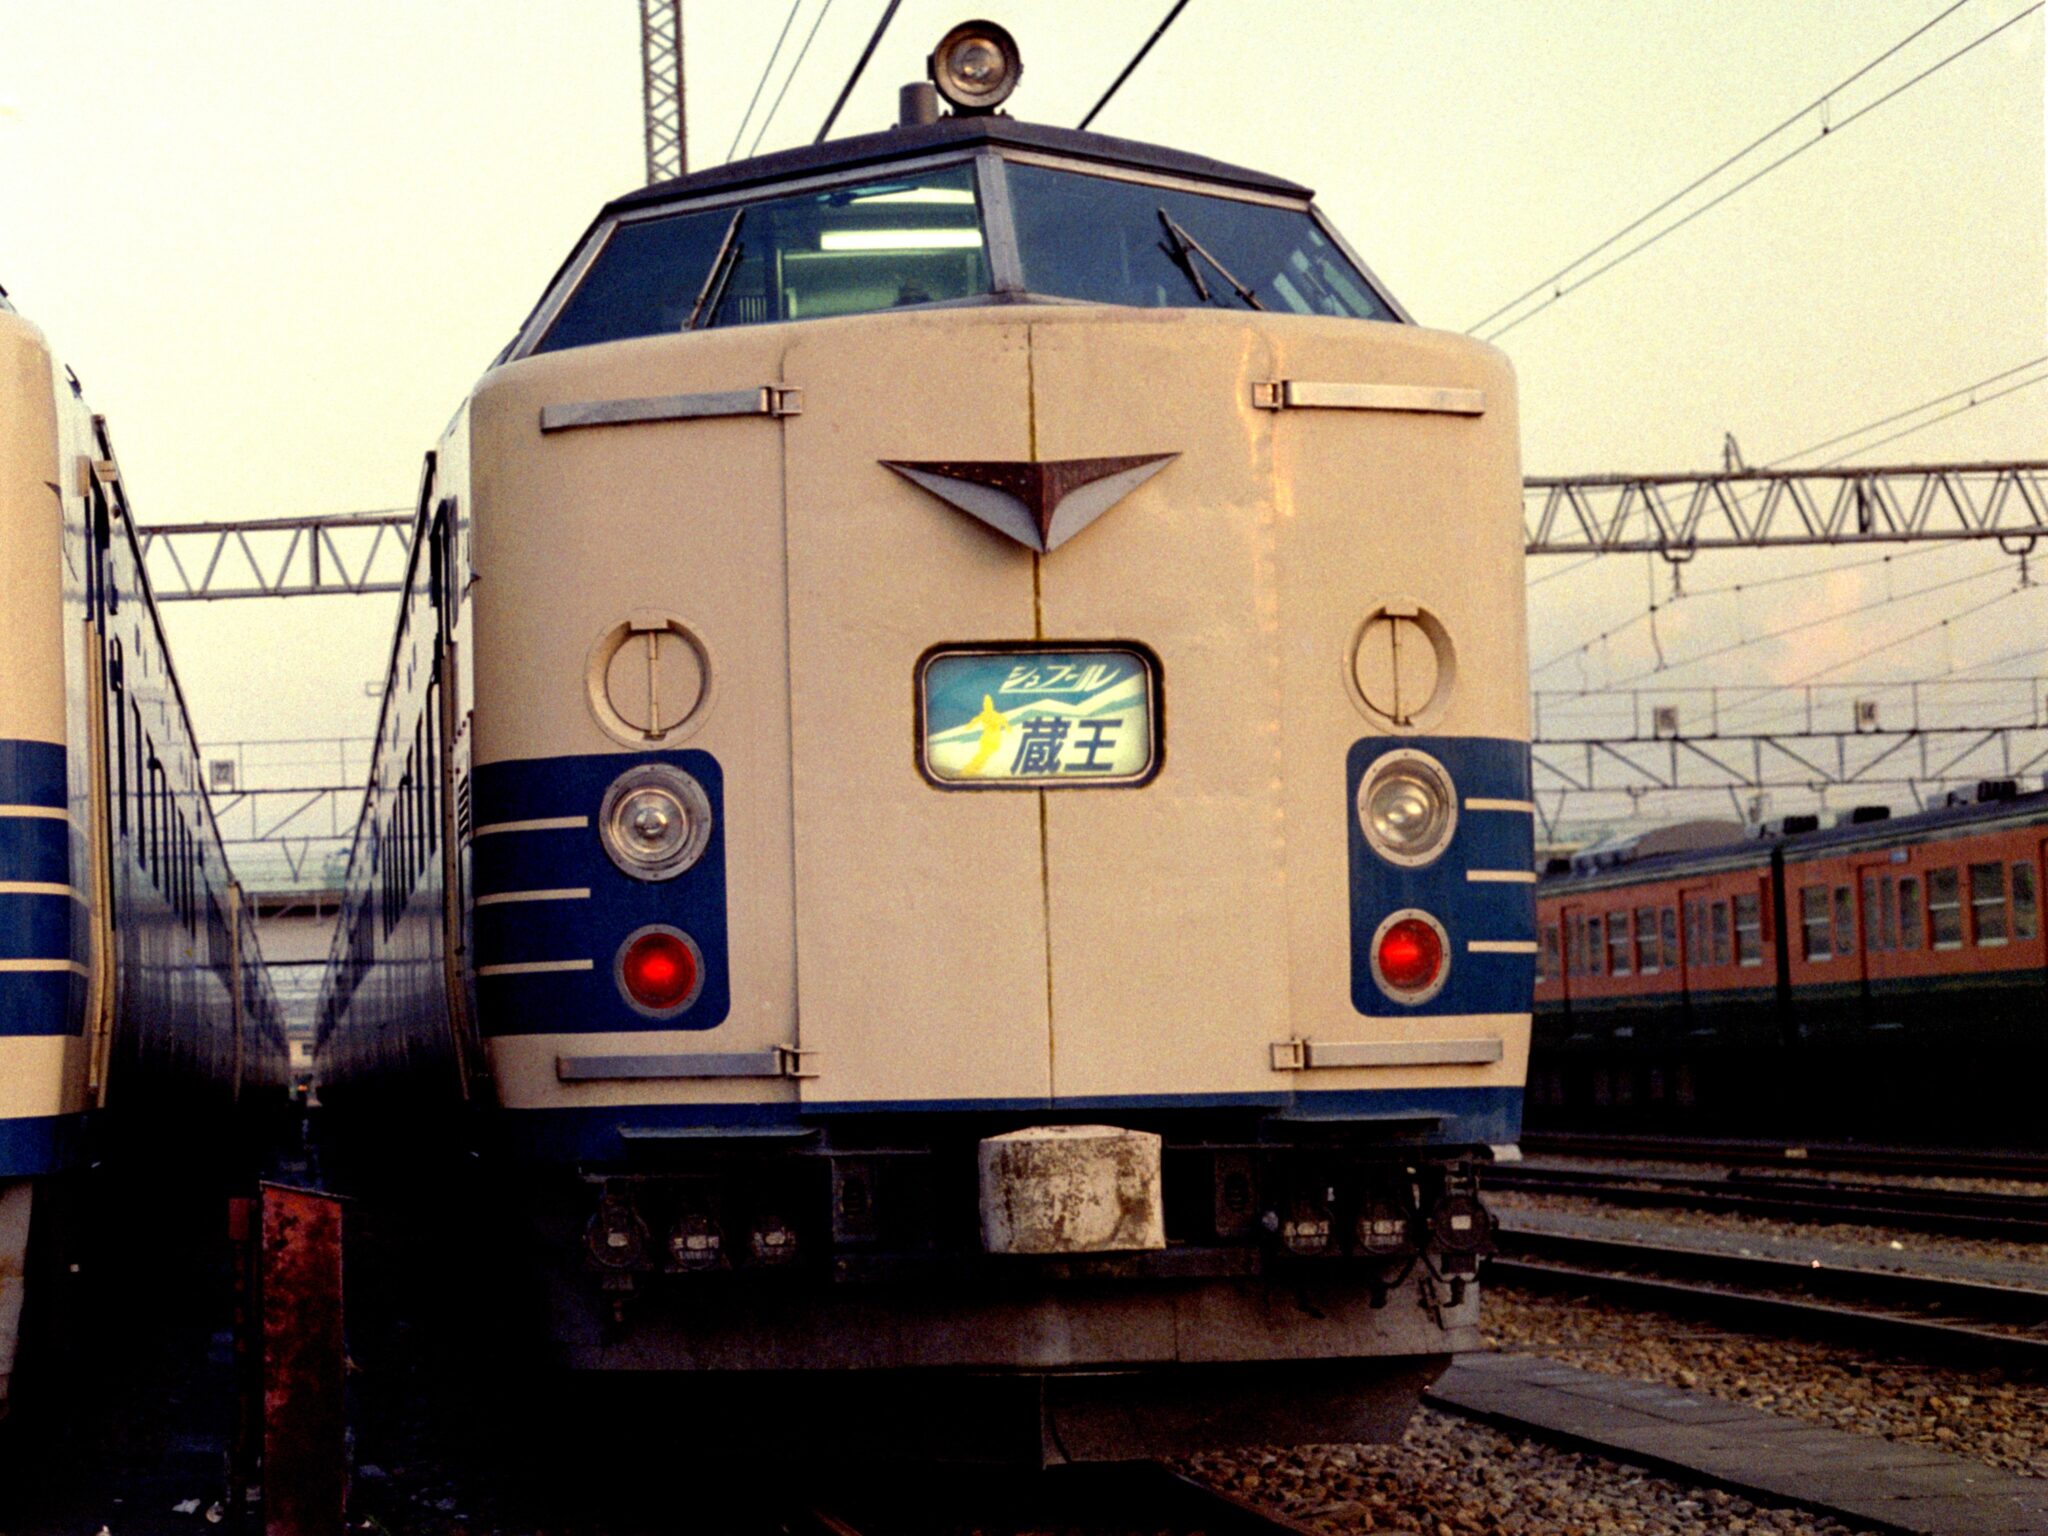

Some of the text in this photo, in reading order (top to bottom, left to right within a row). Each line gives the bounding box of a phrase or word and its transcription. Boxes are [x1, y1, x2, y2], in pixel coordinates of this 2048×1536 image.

[999, 664, 1121, 694] シュプール
[1010, 716, 1123, 775] 蔵王
